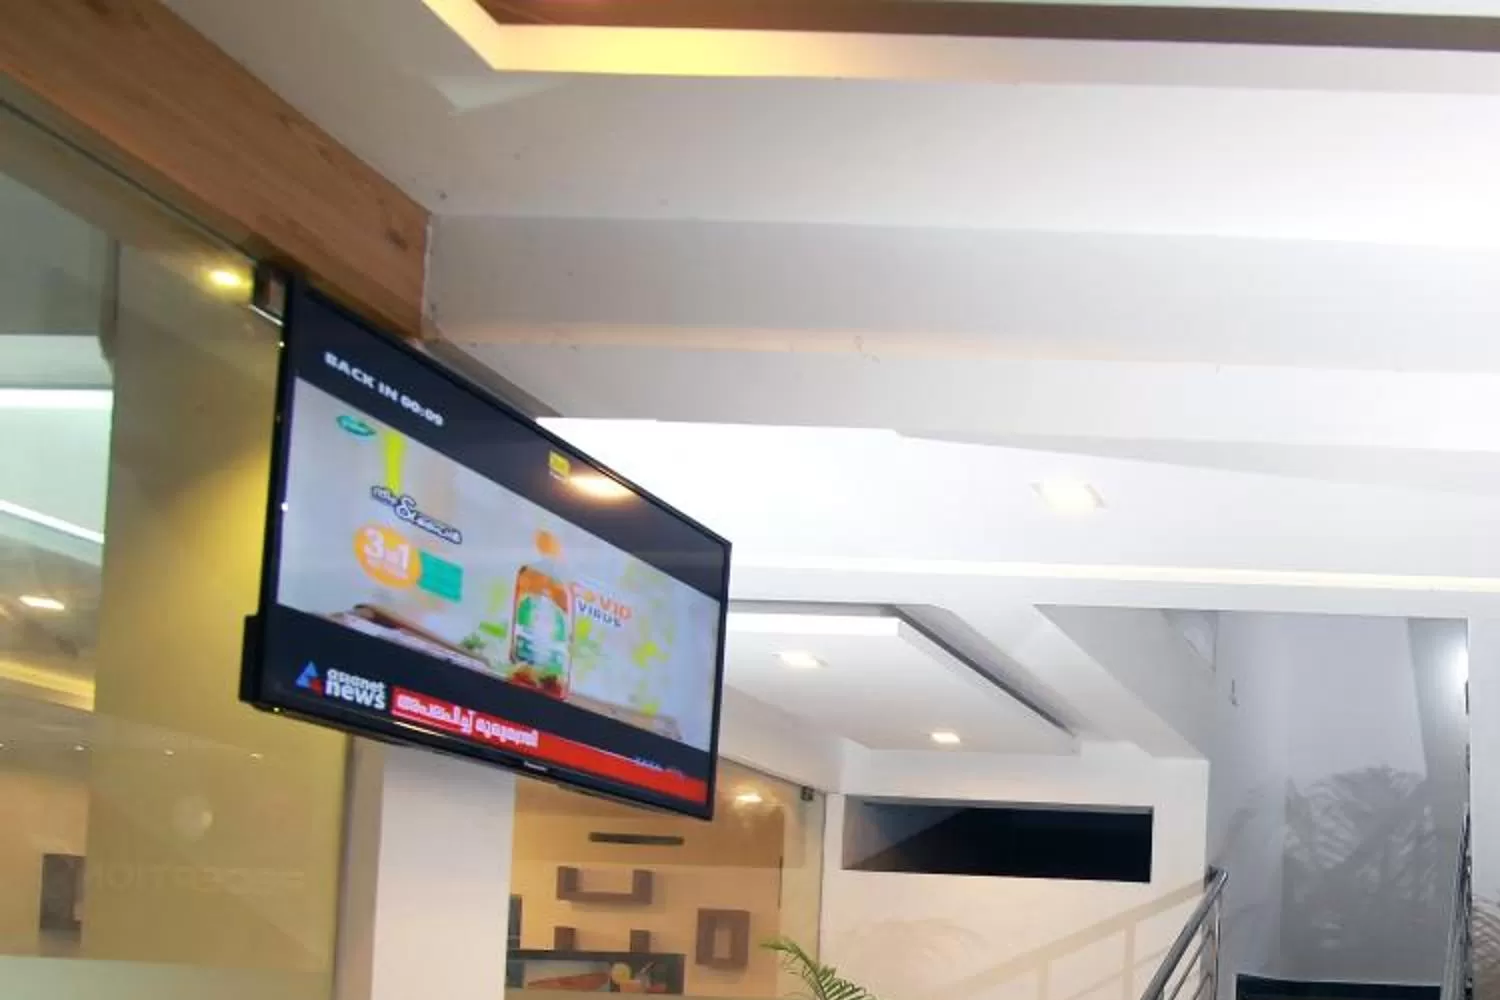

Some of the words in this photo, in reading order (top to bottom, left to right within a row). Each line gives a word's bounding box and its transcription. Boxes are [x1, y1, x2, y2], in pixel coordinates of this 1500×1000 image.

[324, 351, 374, 389] BACK
[377, 381, 398, 402] IN
[325, 679, 386, 710] news
